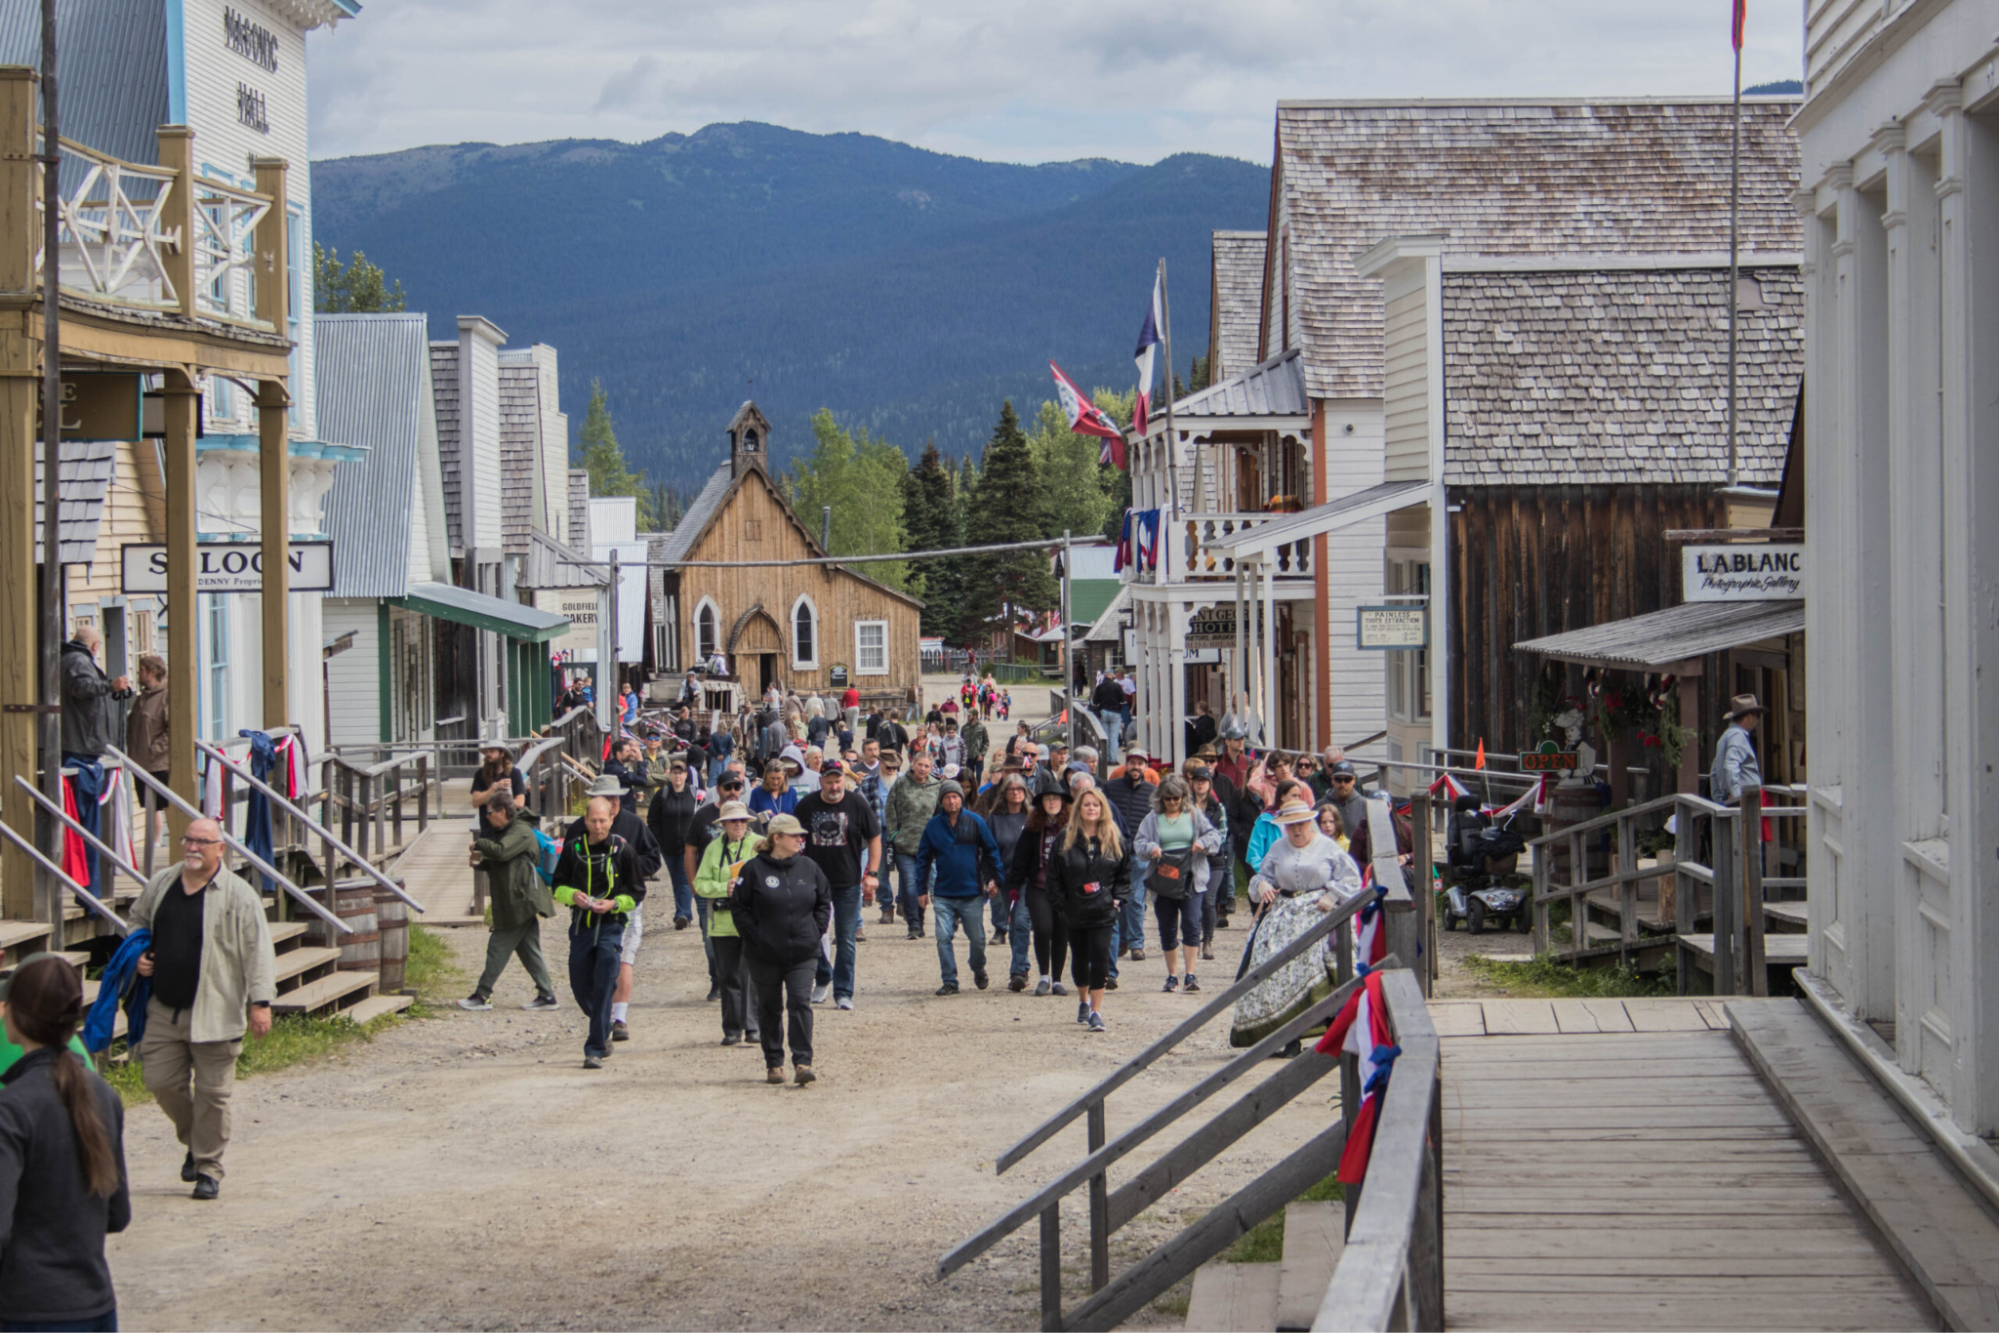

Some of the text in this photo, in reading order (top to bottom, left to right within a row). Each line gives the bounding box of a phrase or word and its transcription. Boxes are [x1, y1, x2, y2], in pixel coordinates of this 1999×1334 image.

[224, 5, 279, 74] MASONIC
[237, 81, 269, 134] HALL
[149, 551, 303, 574] SLON
[198, 577, 262, 587] DENNY Propri
[1761, 575, 1800, 593] Gallery
[1193, 622, 1237, 633] HOTE
[1523, 754, 1576, 770] OPEN
